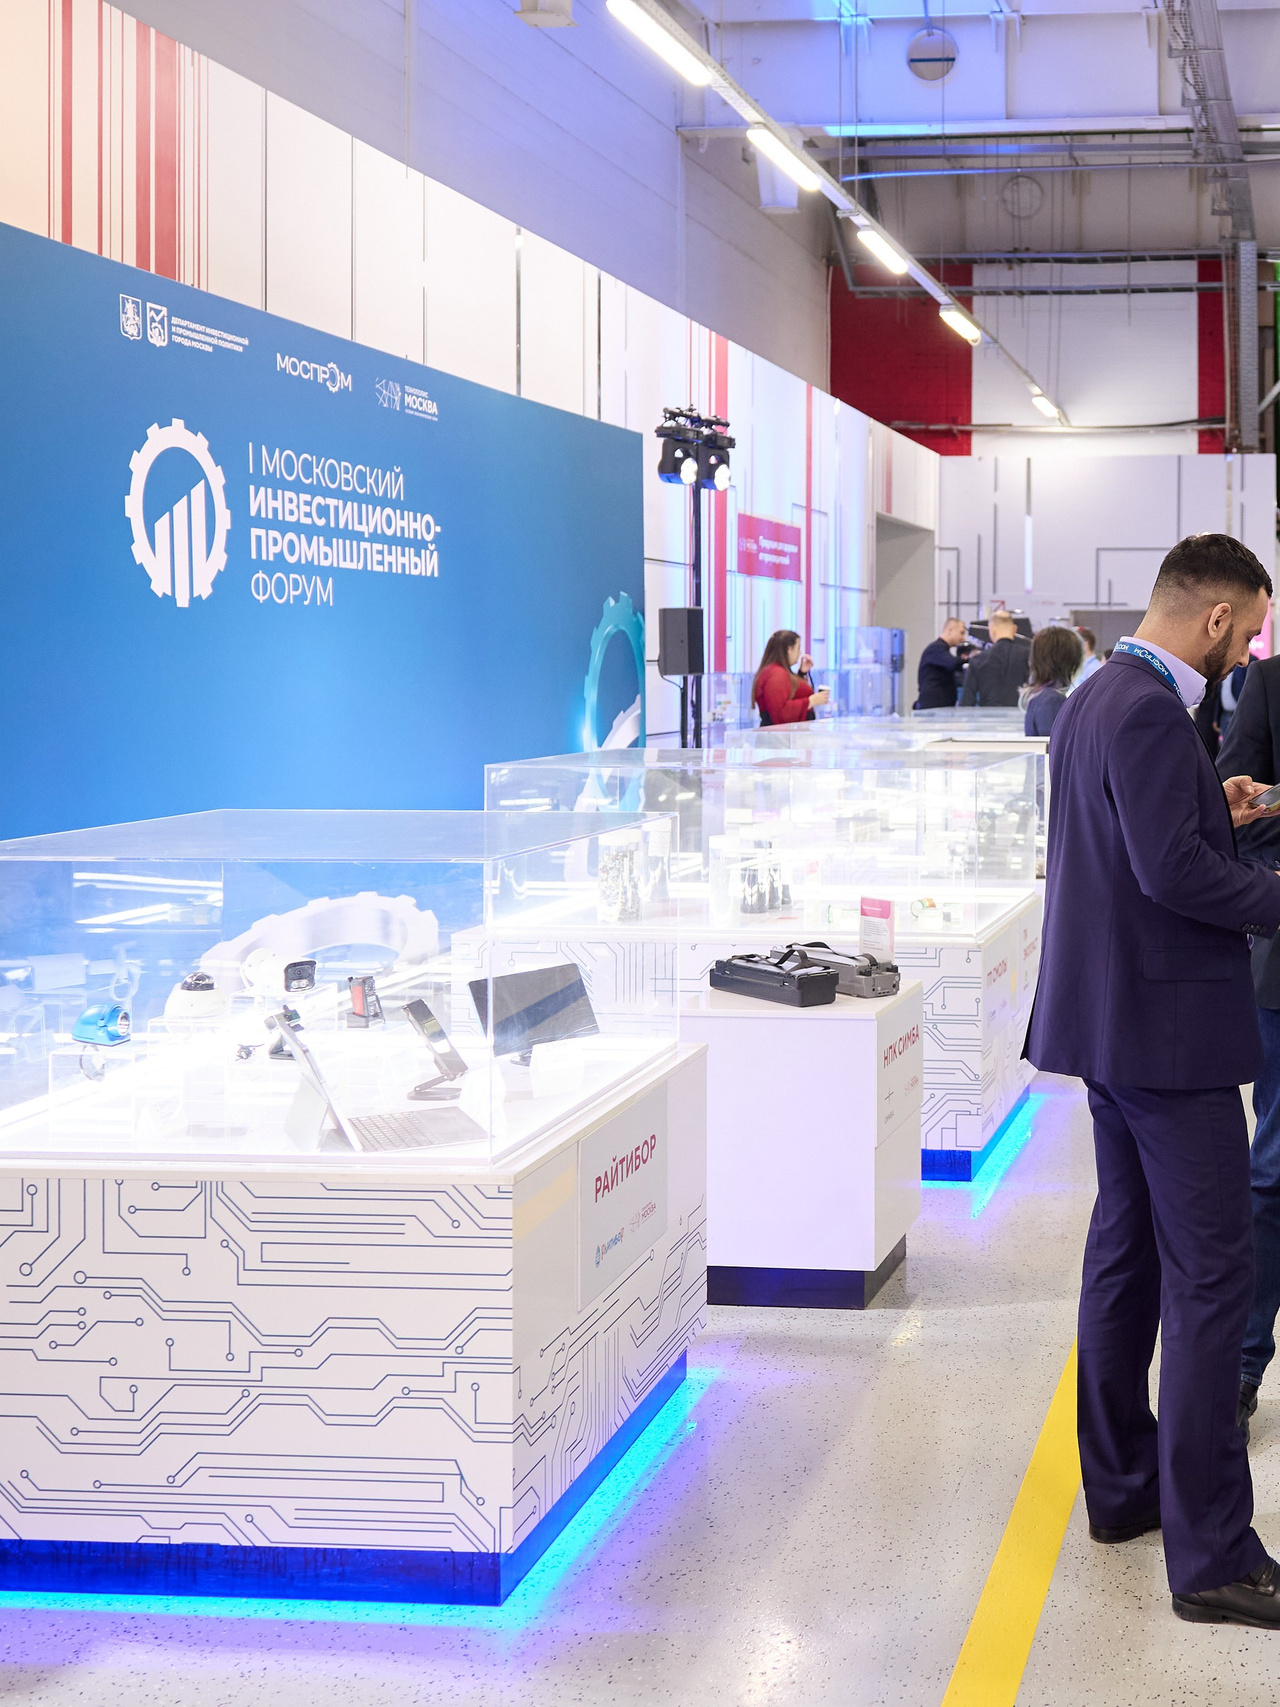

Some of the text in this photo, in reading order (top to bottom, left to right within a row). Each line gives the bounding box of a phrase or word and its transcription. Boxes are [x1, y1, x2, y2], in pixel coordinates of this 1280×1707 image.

[276, 352, 352, 394] МОСПРОМ
[404, 393, 439, 416] МОСКВА
[261, 444, 404, 501] МОСКОВСКИЙ
[249, 484, 442, 542] ИНВЕСТИЦИОННО-
[250, 527, 438, 578] ПРОМЫШЛЕННЫЙ
[250, 570, 334, 606] ФОРУМ
[883, 1023, 920, 1069] НПК СИМБА
[595, 1134, 657, 1203] РАЙТИБОР
